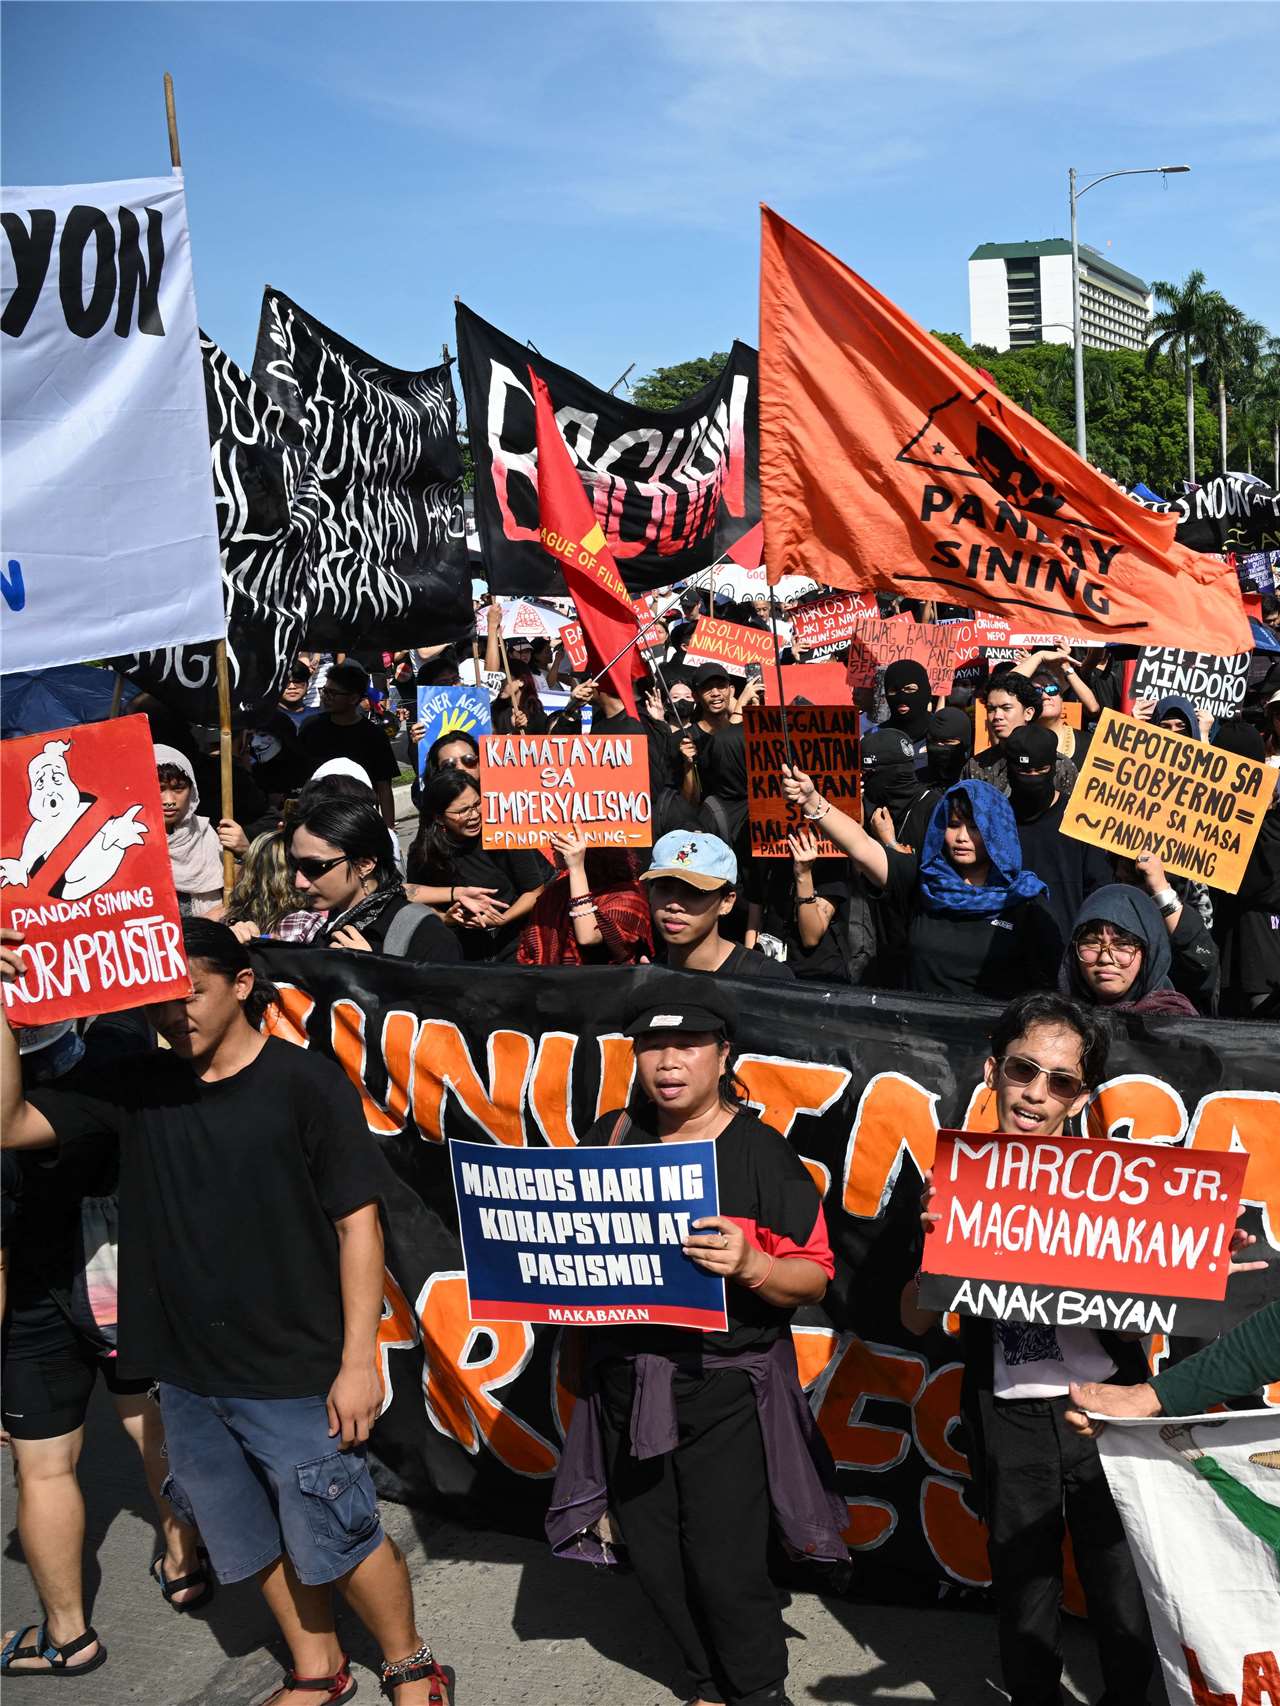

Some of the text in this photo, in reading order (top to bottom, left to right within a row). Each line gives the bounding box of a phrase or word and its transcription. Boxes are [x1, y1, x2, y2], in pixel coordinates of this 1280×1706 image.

[577, 551, 598, 576] OF
[930, 540, 1110, 615] SINING
[701, 618, 740, 640] ISOLI
[792, 600, 844, 625] MARCOS
[824, 618, 836, 630] SA
[812, 639, 852, 659] ANAKBA
[853, 620, 897, 644] HUWAG
[907, 624, 958, 650] GAWING
[928, 646, 954, 668] ANG
[1136, 658, 1248, 703] MINDORO
[419, 692, 491, 728] NEVER AGAIN
[486, 738, 634, 768] KAMATAYAN
[1102, 719, 1264, 798] NEPOTISMO SA
[540, 768, 575, 788] SA
[484, 788, 651, 825] IMPERYALISMO
[1084, 777, 1241, 854] PAHIRAP SA MASA
[1161, 838, 1217, 878] SINING
[12, 886, 154, 931] PANDAY SINING
[461, 1161, 704, 1203] MARCOS HARI NG
[949, 1138, 1229, 1203] MARCOS JR.
[479, 1206, 692, 1246] KORAPSYON AT
[945, 1195, 1226, 1273] MAGNANAKAW!
[518, 1251, 664, 1288] PASISMO!
[547, 1307, 650, 1324] MAKABAYAN
